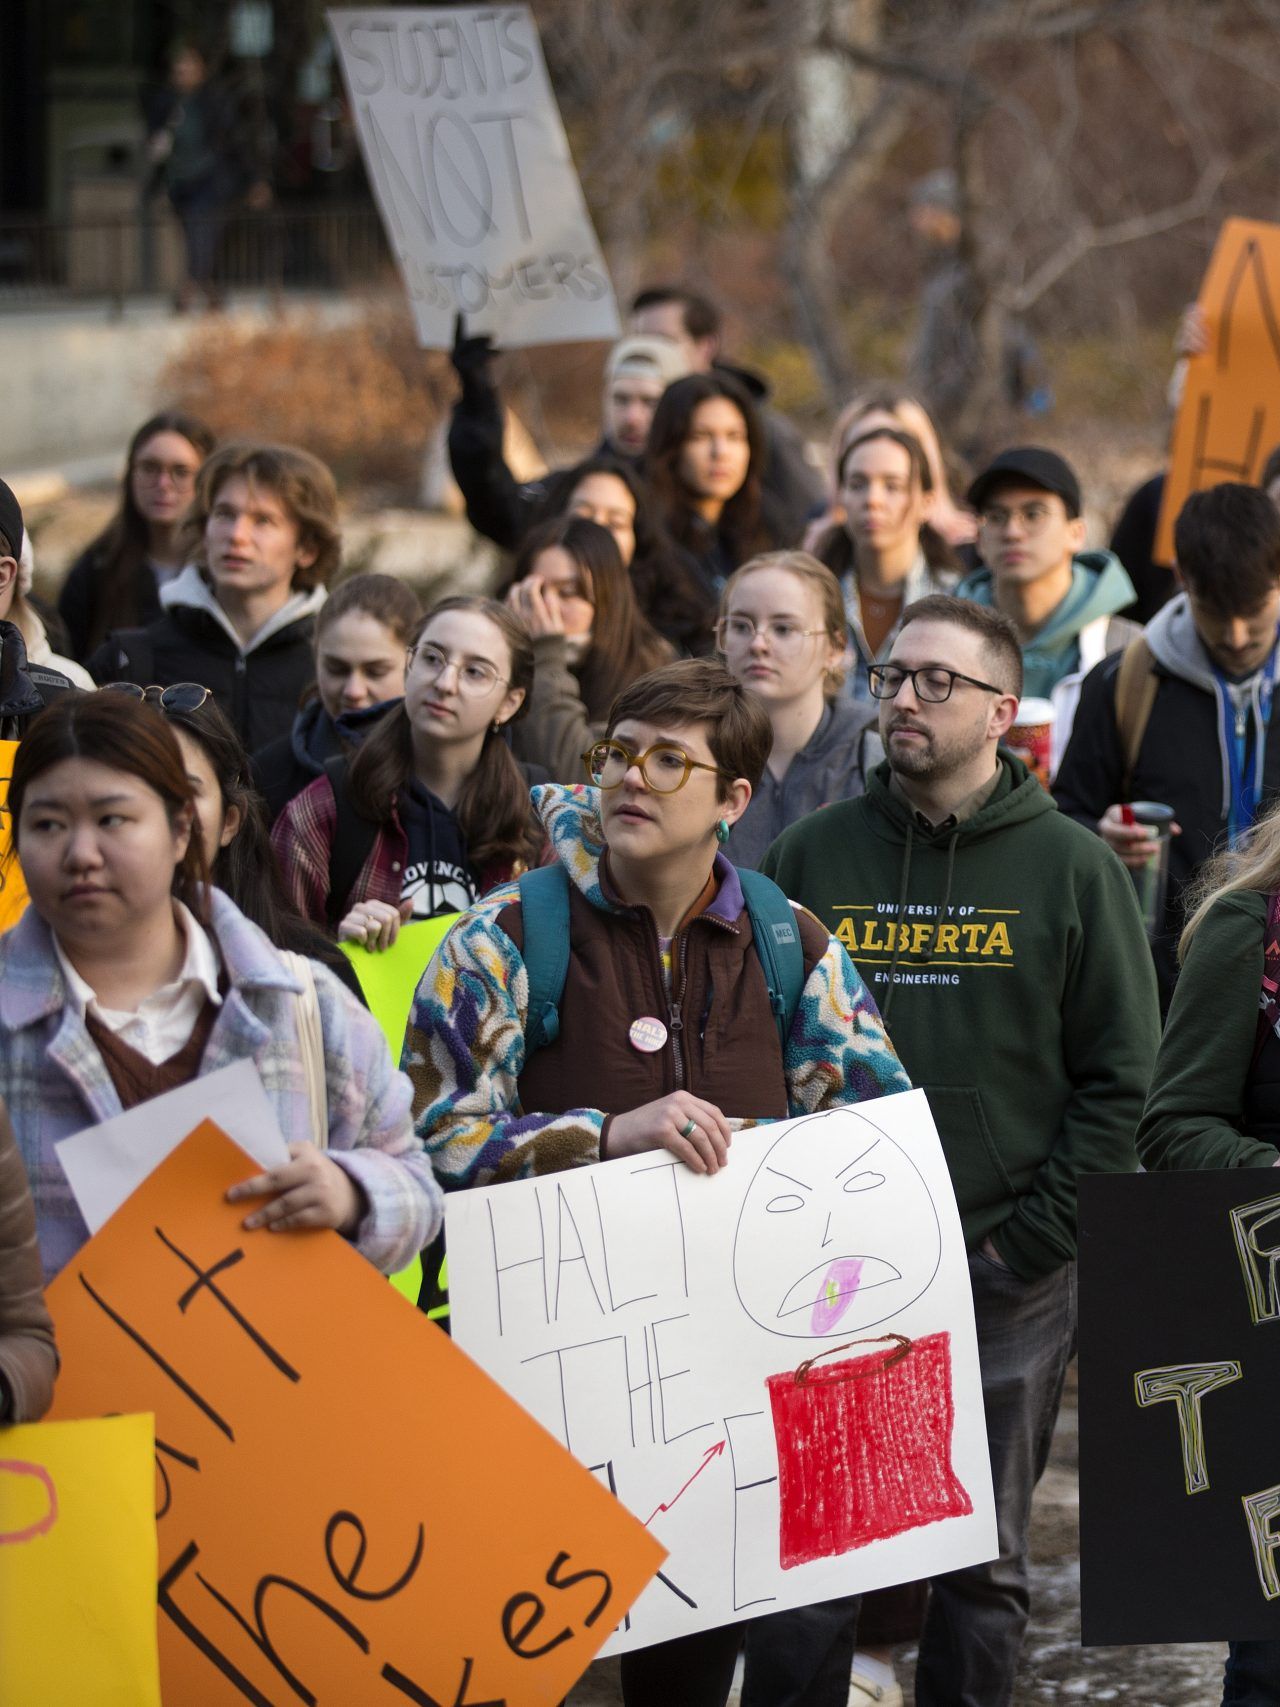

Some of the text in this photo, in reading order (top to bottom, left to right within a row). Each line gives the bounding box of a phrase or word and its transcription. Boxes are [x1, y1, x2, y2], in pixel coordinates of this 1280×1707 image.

[346, 9, 534, 100] STUDENTS
[360, 101, 532, 249] NOT
[775, 928, 793, 939] MEC
[834, 917, 1013, 956] ALBERTA
[959, 905, 975, 916] OF
[875, 972, 960, 985] ENGINEERING
[486, 1162, 689, 1336] HALT
[521, 1313, 715, 1453] THE
